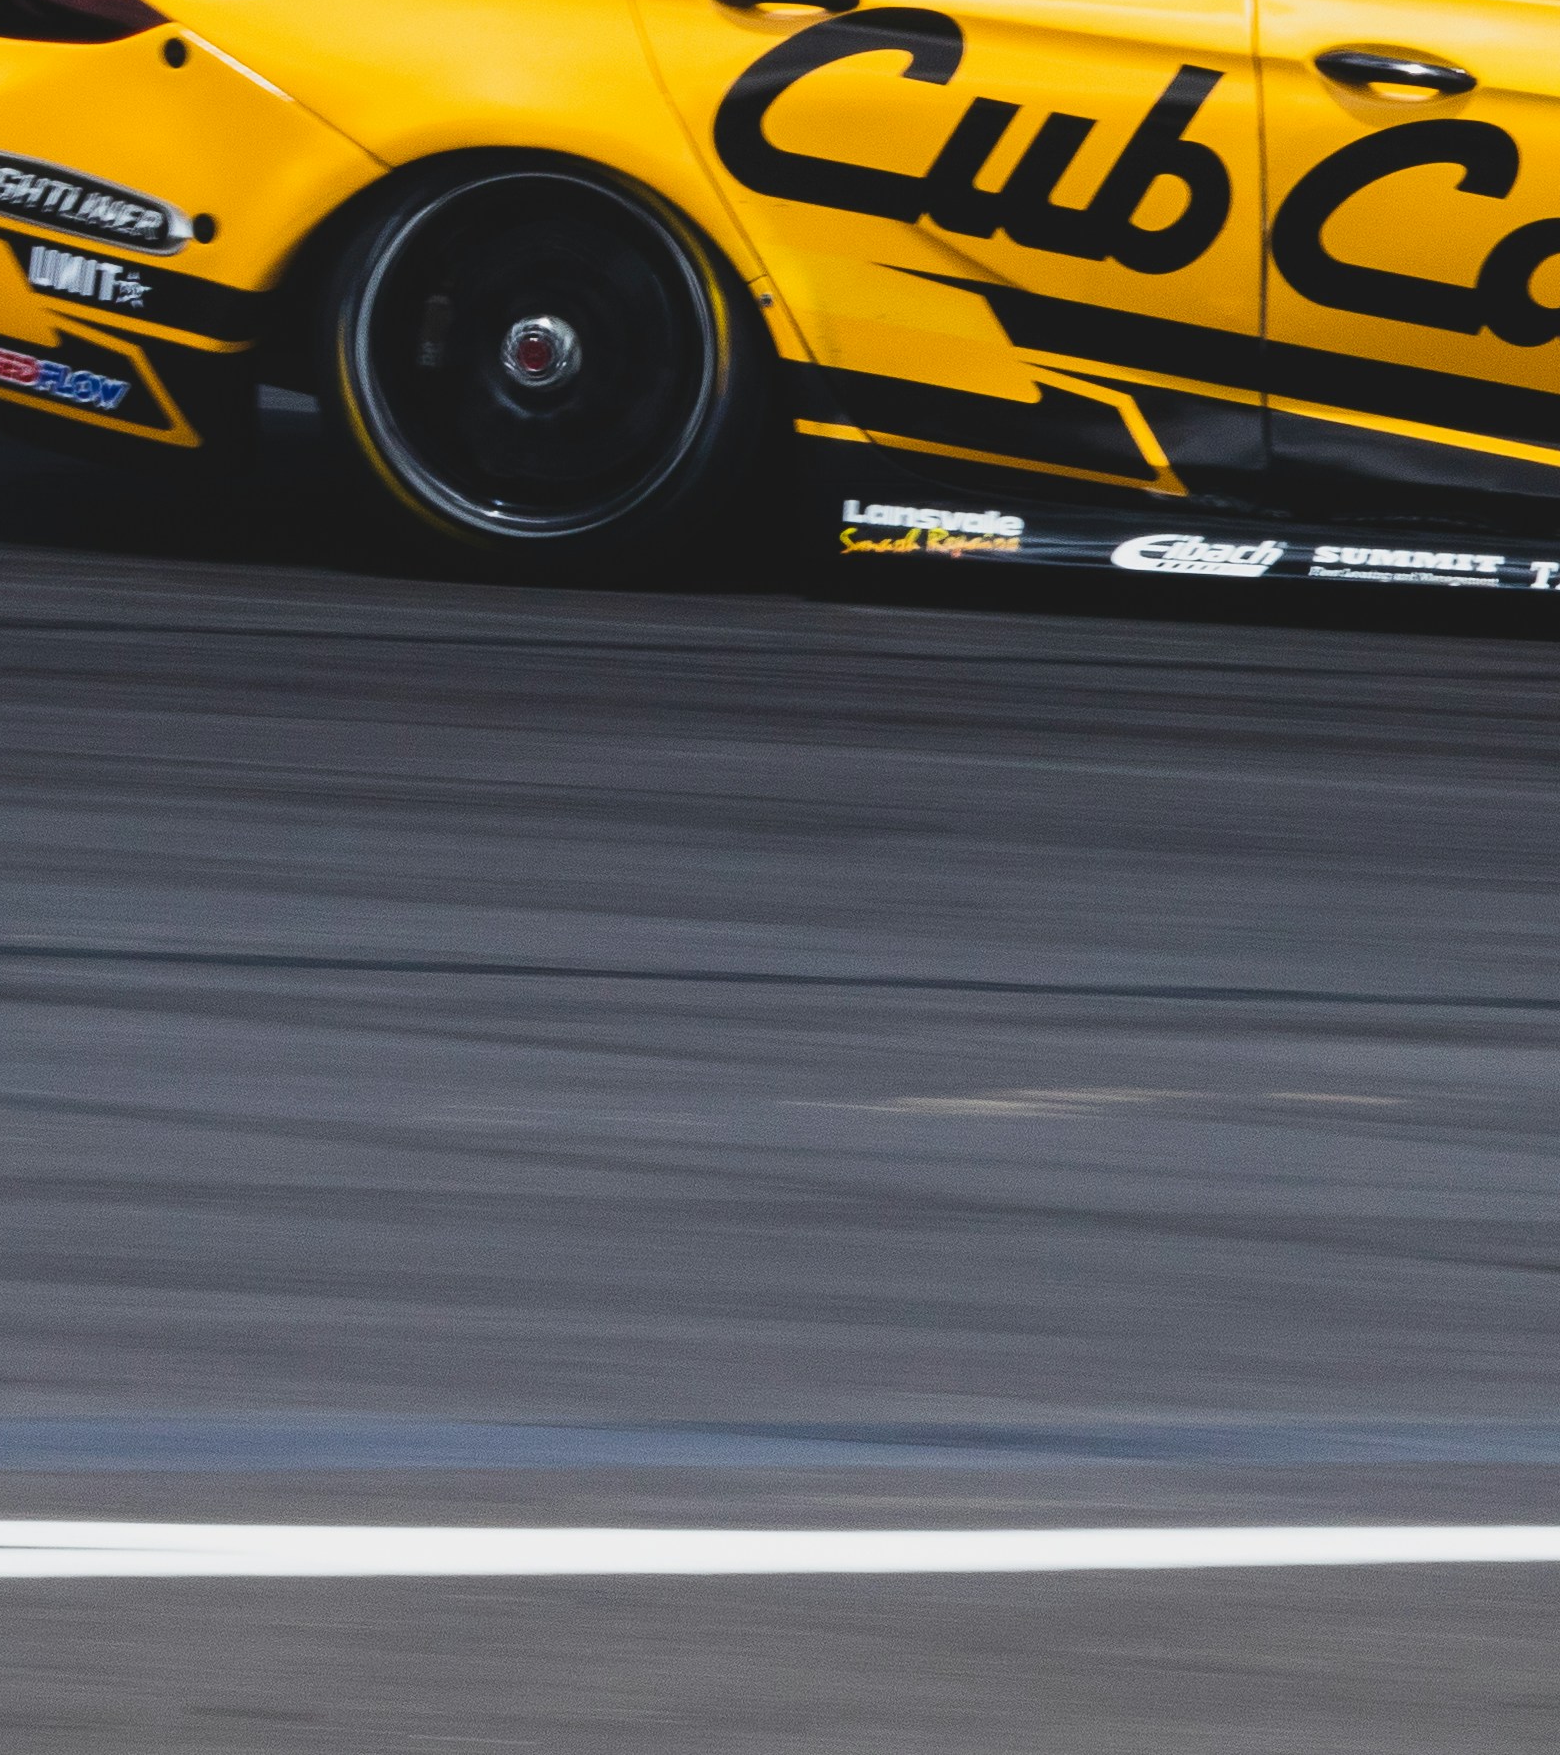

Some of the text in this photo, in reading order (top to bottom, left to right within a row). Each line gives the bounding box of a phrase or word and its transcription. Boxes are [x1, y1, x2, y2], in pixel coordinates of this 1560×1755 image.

[712, 7, 1230, 276] Cub
[29, 245, 124, 303] UNIT
[842, 500, 1025, 537] Lansvale
[1110, 534, 1289, 576] Eibach
[1312, 546, 1506, 573] SUMMIT
